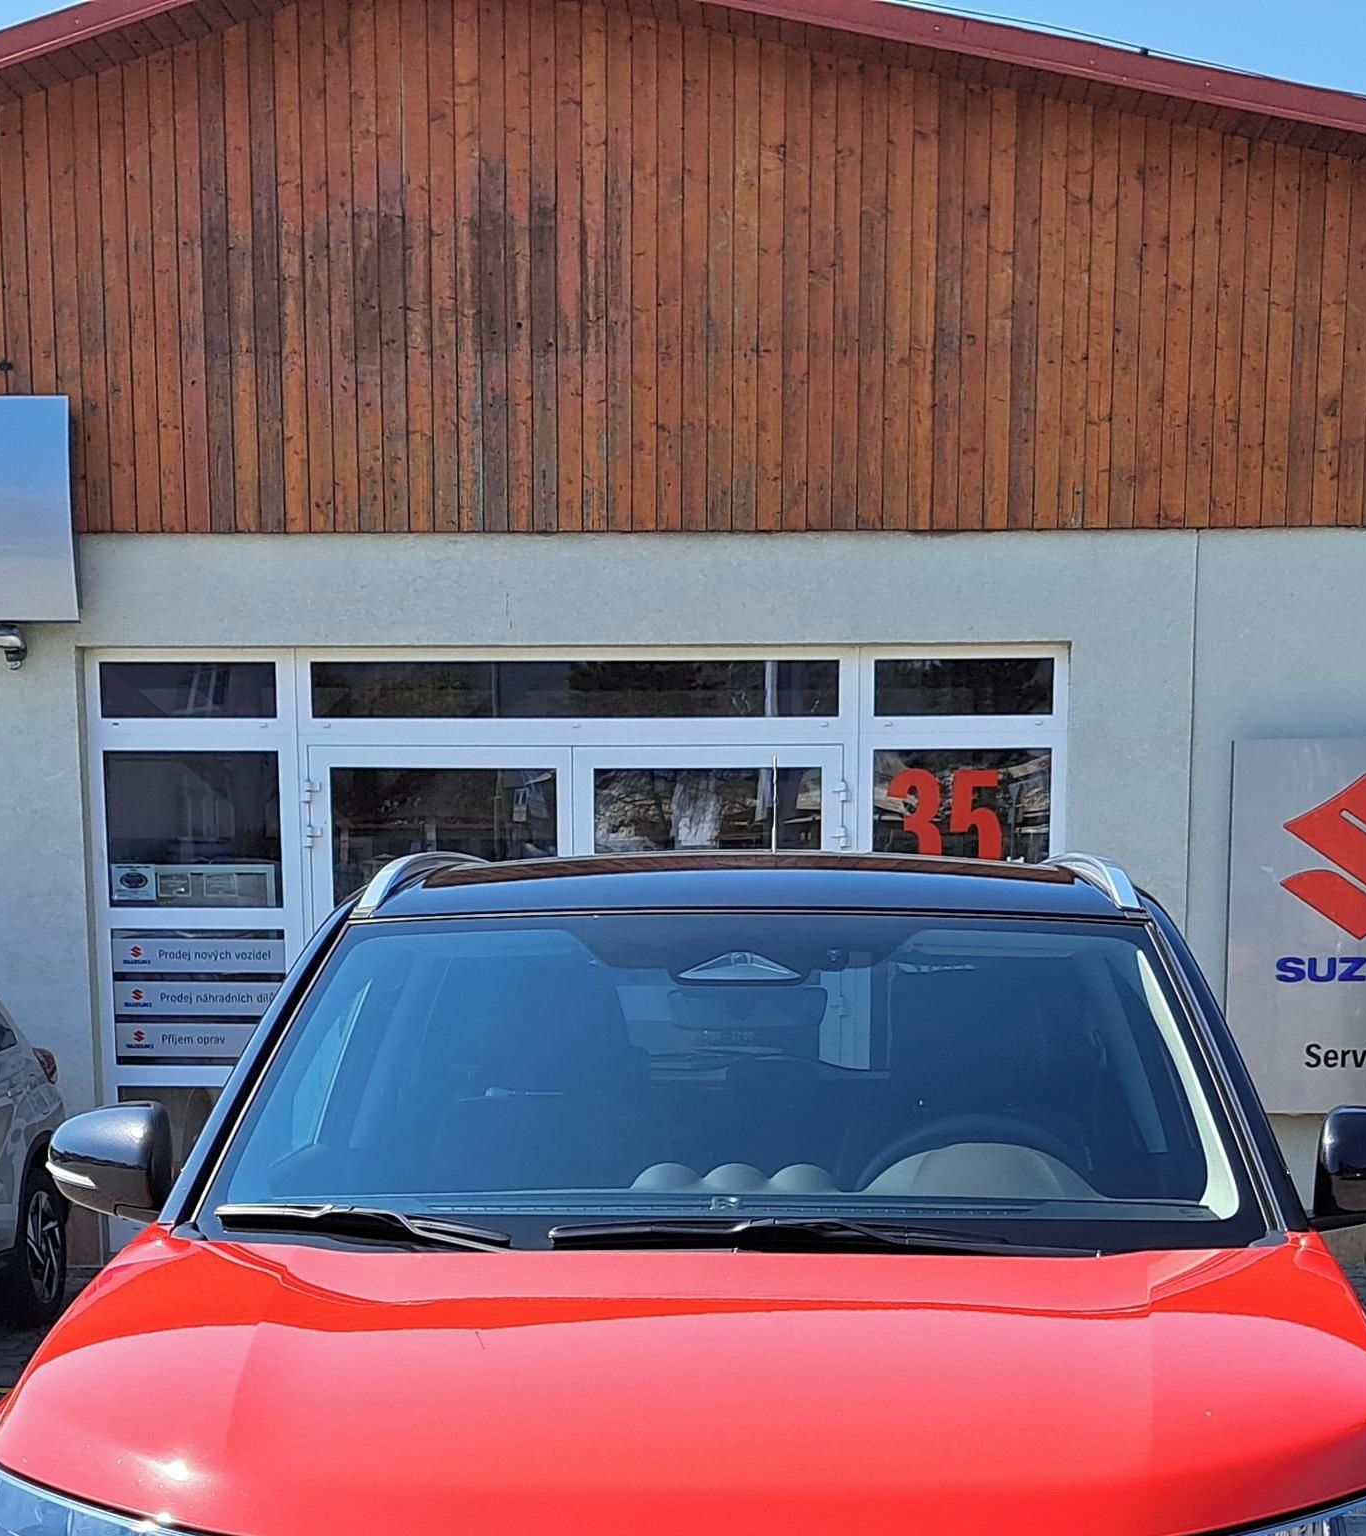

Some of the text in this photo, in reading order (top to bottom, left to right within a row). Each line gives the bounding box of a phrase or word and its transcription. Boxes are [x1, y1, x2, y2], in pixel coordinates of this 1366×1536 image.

[887, 767, 1003, 862] 35
[158, 949, 272, 962] Prodej nových vozidel
[160, 992, 193, 1005] Prodej
[196, 992, 253, 1004] náhradních
[161, 1033, 226, 1046] Příjem oprav
